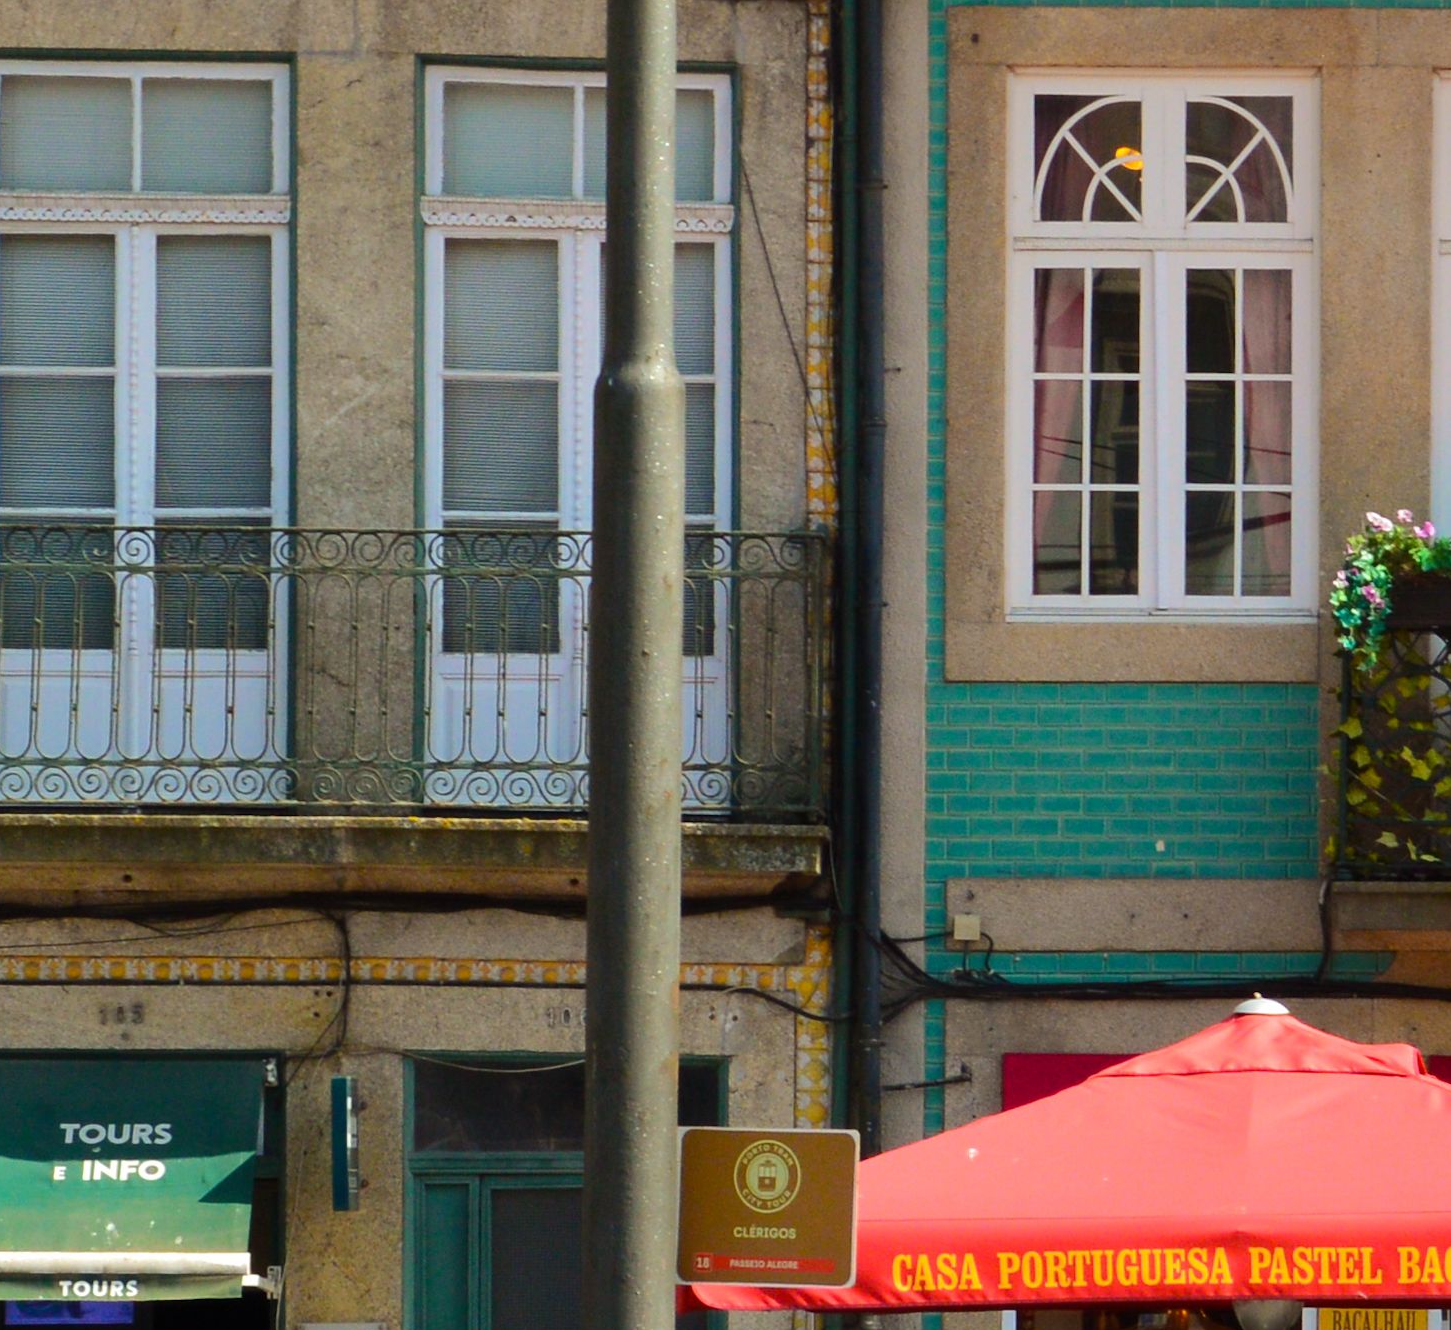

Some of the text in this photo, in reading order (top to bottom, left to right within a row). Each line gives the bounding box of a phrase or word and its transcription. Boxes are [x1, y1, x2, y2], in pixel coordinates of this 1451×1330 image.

[60, 1123, 172, 1145] TOURS
[53, 1159, 166, 1181] E INFO
[733, 1224, 796, 1239] CLÉRIGOS
[696, 1257, 710, 1269] 18
[766, 1259, 799, 1270] ALEGRE
[892, 1251, 982, 1293] CASA
[997, 1246, 1232, 1289] PORTUGUESA
[1248, 1245, 1382, 1285] PASTEL
[59, 1280, 139, 1297] TOURS
